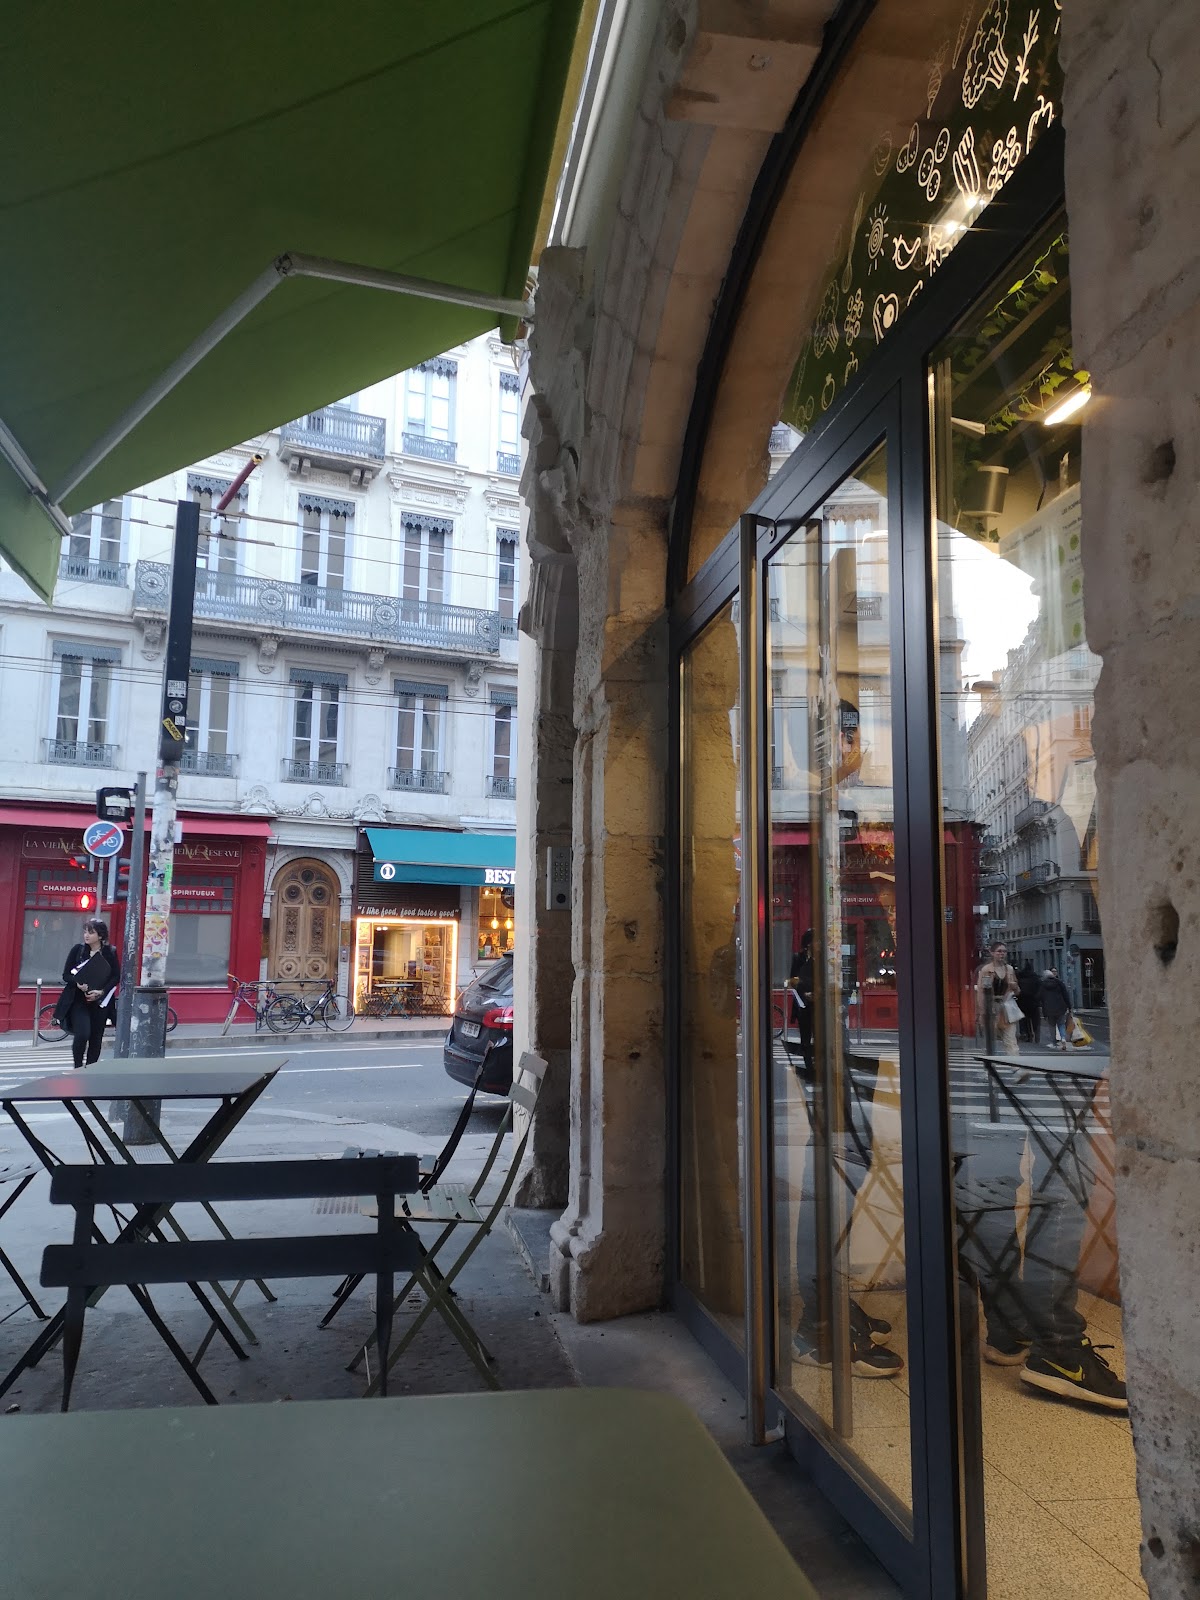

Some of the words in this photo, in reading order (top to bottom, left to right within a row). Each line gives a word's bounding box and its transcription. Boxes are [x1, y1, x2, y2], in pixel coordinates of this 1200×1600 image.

[26, 840, 39, 848] LA
[172, 889, 216, 897] SPIRITUEUX
[366, 906, 380, 915] like
[400, 907, 416, 918] food
[417, 908, 437, 917] tastes
